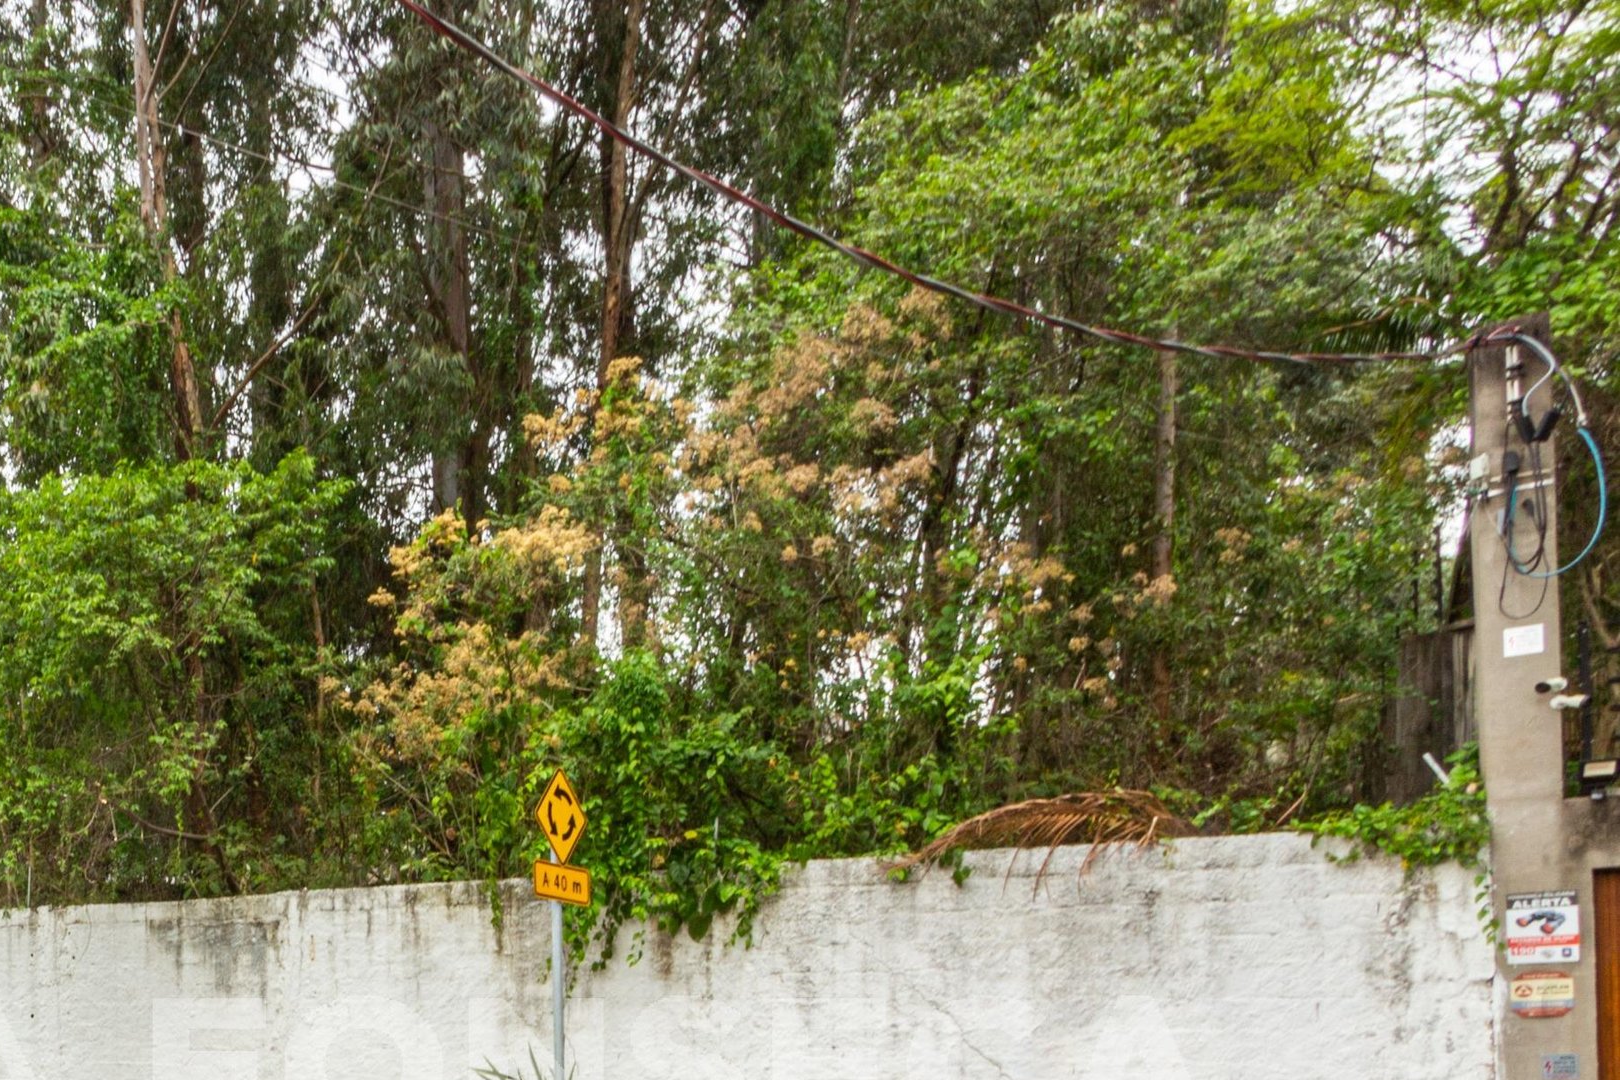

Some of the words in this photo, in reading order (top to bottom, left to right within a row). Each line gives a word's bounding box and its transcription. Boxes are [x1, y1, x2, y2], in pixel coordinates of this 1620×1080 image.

[543, 871, 549, 888] A
[554, 874, 567, 892] 40
[573, 881, 582, 895] m
[1511, 896, 1572, 910] ALERTA
